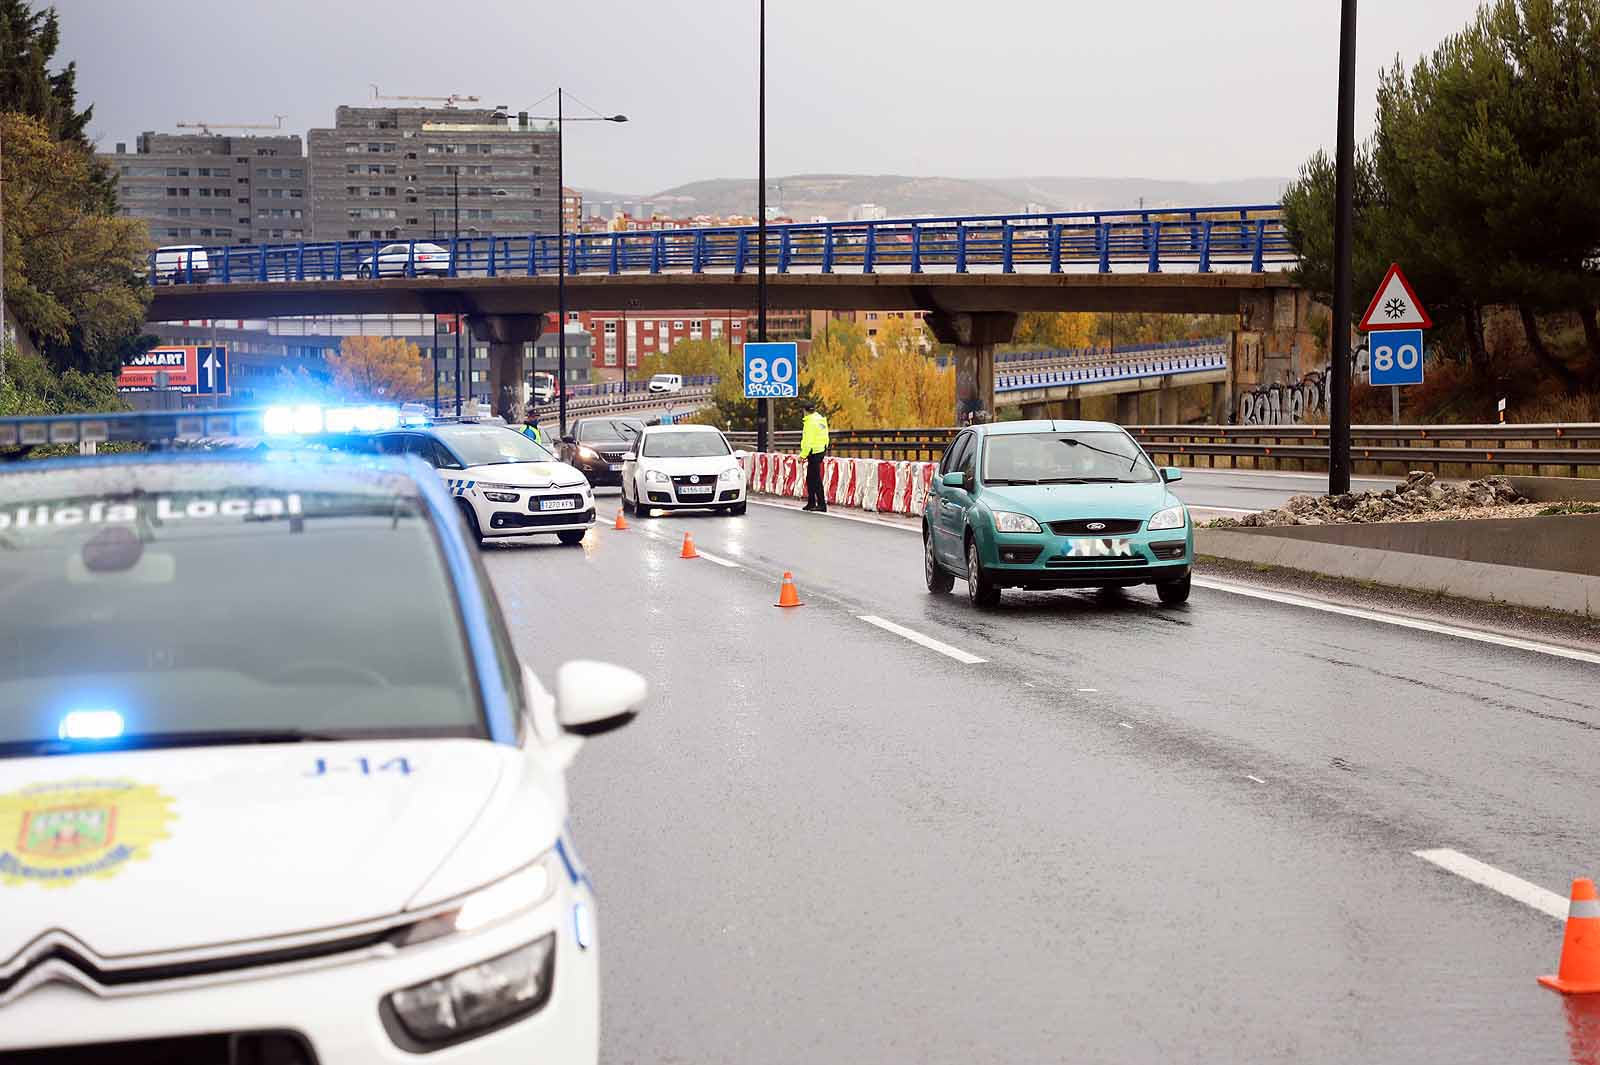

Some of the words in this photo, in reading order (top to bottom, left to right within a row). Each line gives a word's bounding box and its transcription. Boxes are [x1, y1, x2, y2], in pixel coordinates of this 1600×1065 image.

[122, 353, 183, 365] OMART
[749, 357, 793, 383] 80
[1374, 344, 1418, 371] 80
[156, 493, 302, 520] Local
[300, 756, 416, 777] J-14
